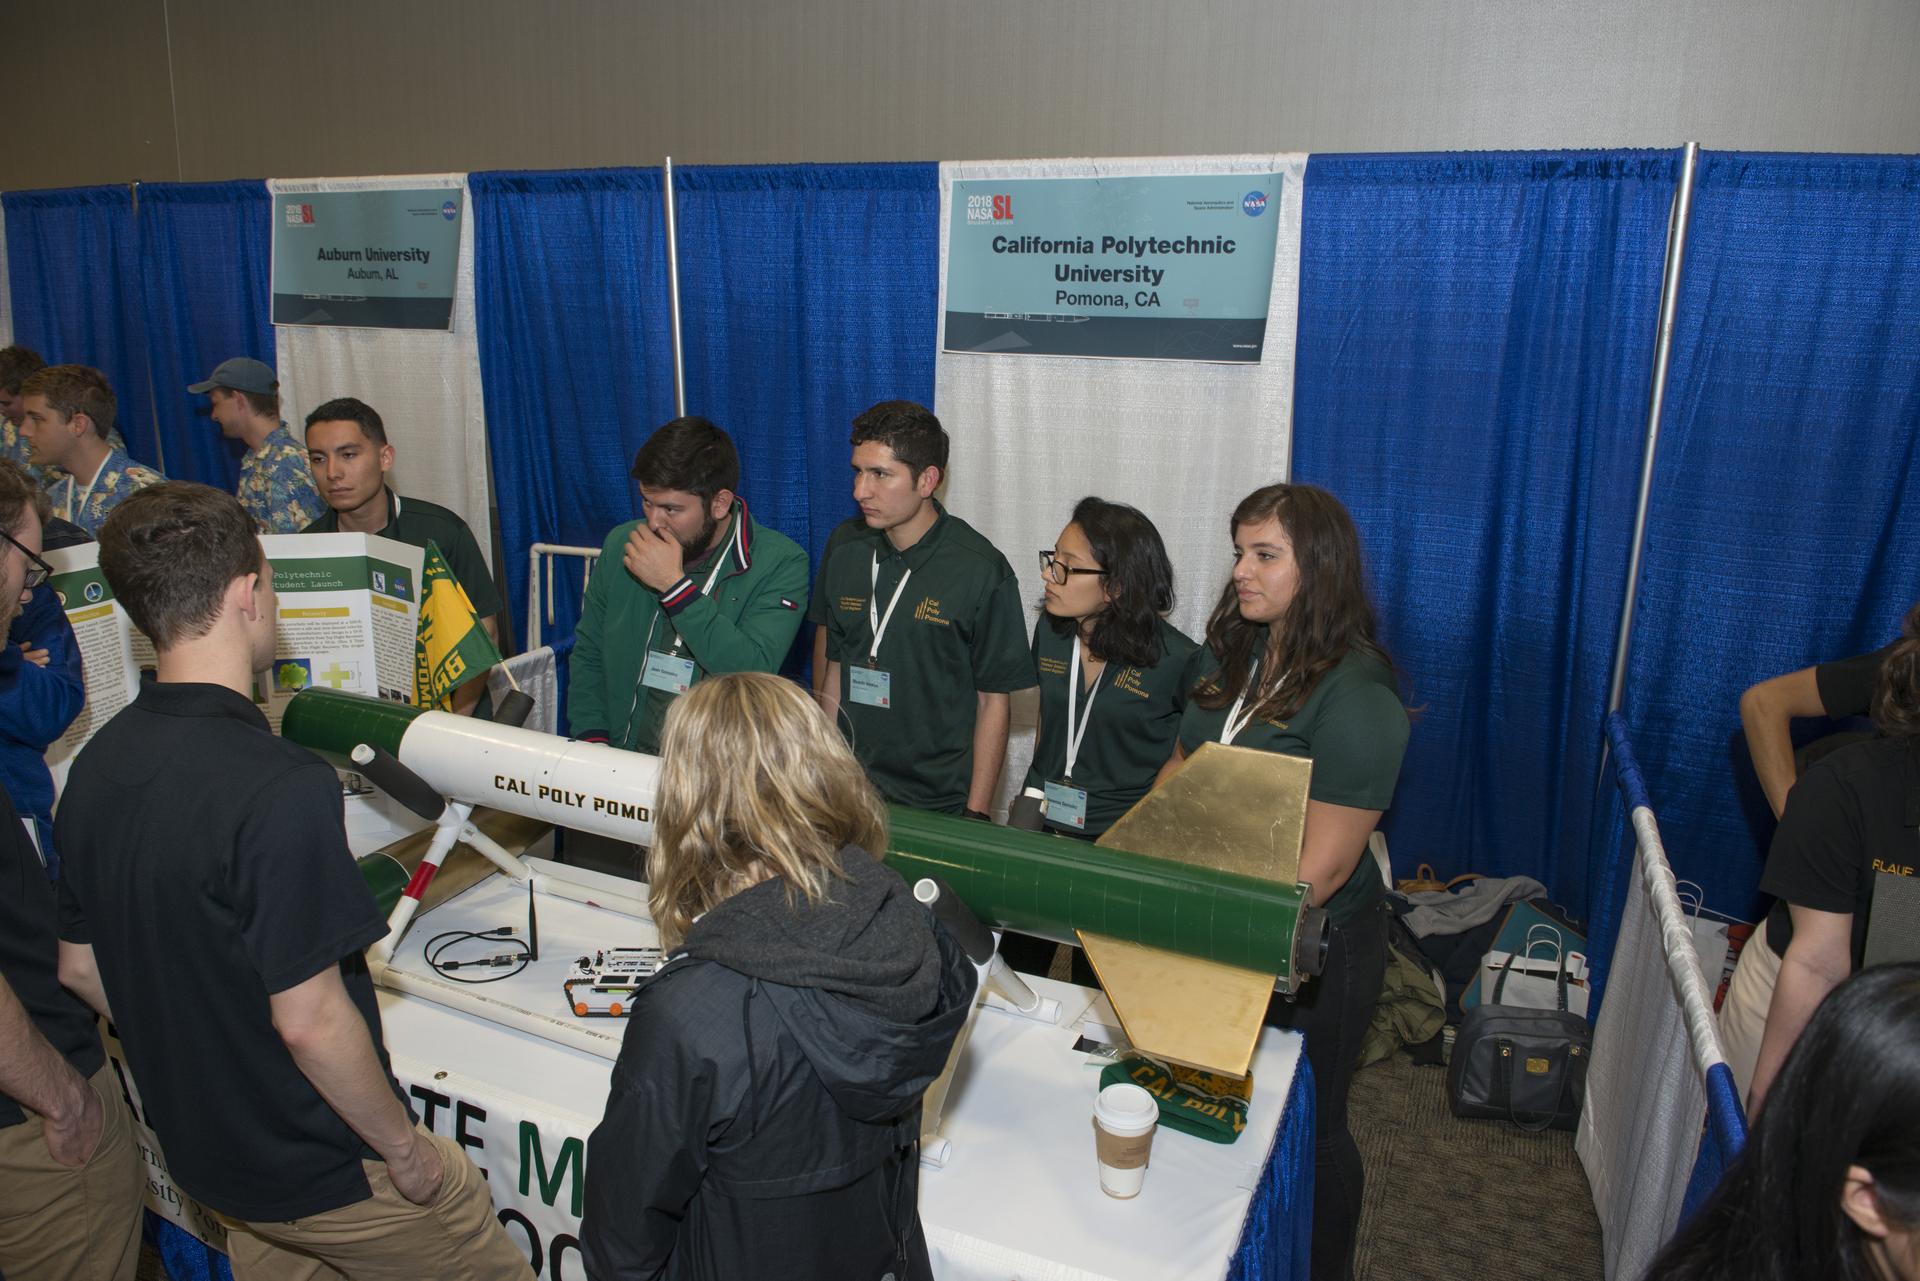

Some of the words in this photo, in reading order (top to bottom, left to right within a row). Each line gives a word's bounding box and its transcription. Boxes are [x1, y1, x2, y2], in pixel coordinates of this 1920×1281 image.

[968, 195, 992, 207] 2018
[993, 194, 1014, 220] SL
[1244, 200, 1265, 208] NASA
[968, 208, 993, 220] NASA
[992, 236, 1094, 254] California
[1101, 236, 1236, 258] Polytechnic
[318, 247, 361, 261] Auburn
[365, 247, 430, 264] University
[348, 267, 383, 281] Auburn,
[385, 268, 399, 280] AL
[1055, 264, 1164, 286] University
[1056, 290, 1129, 309] Pomona,
[1135, 291, 1160, 307] CA
[274, 571, 332, 580] Polytechnic
[311, 580, 343, 588] Launch
[928, 599, 939, 607] Cal
[926, 607, 940, 615] Poly
[925, 614, 949, 625] Pomona
[1130, 668, 1142, 678] Cal
[1127, 676, 1142, 687] Poly
[1124, 683, 1149, 699] Pomona
[494, 775, 531, 796] CAL
[539, 785, 585, 808] POLY
[594, 797, 655, 824] POMO
